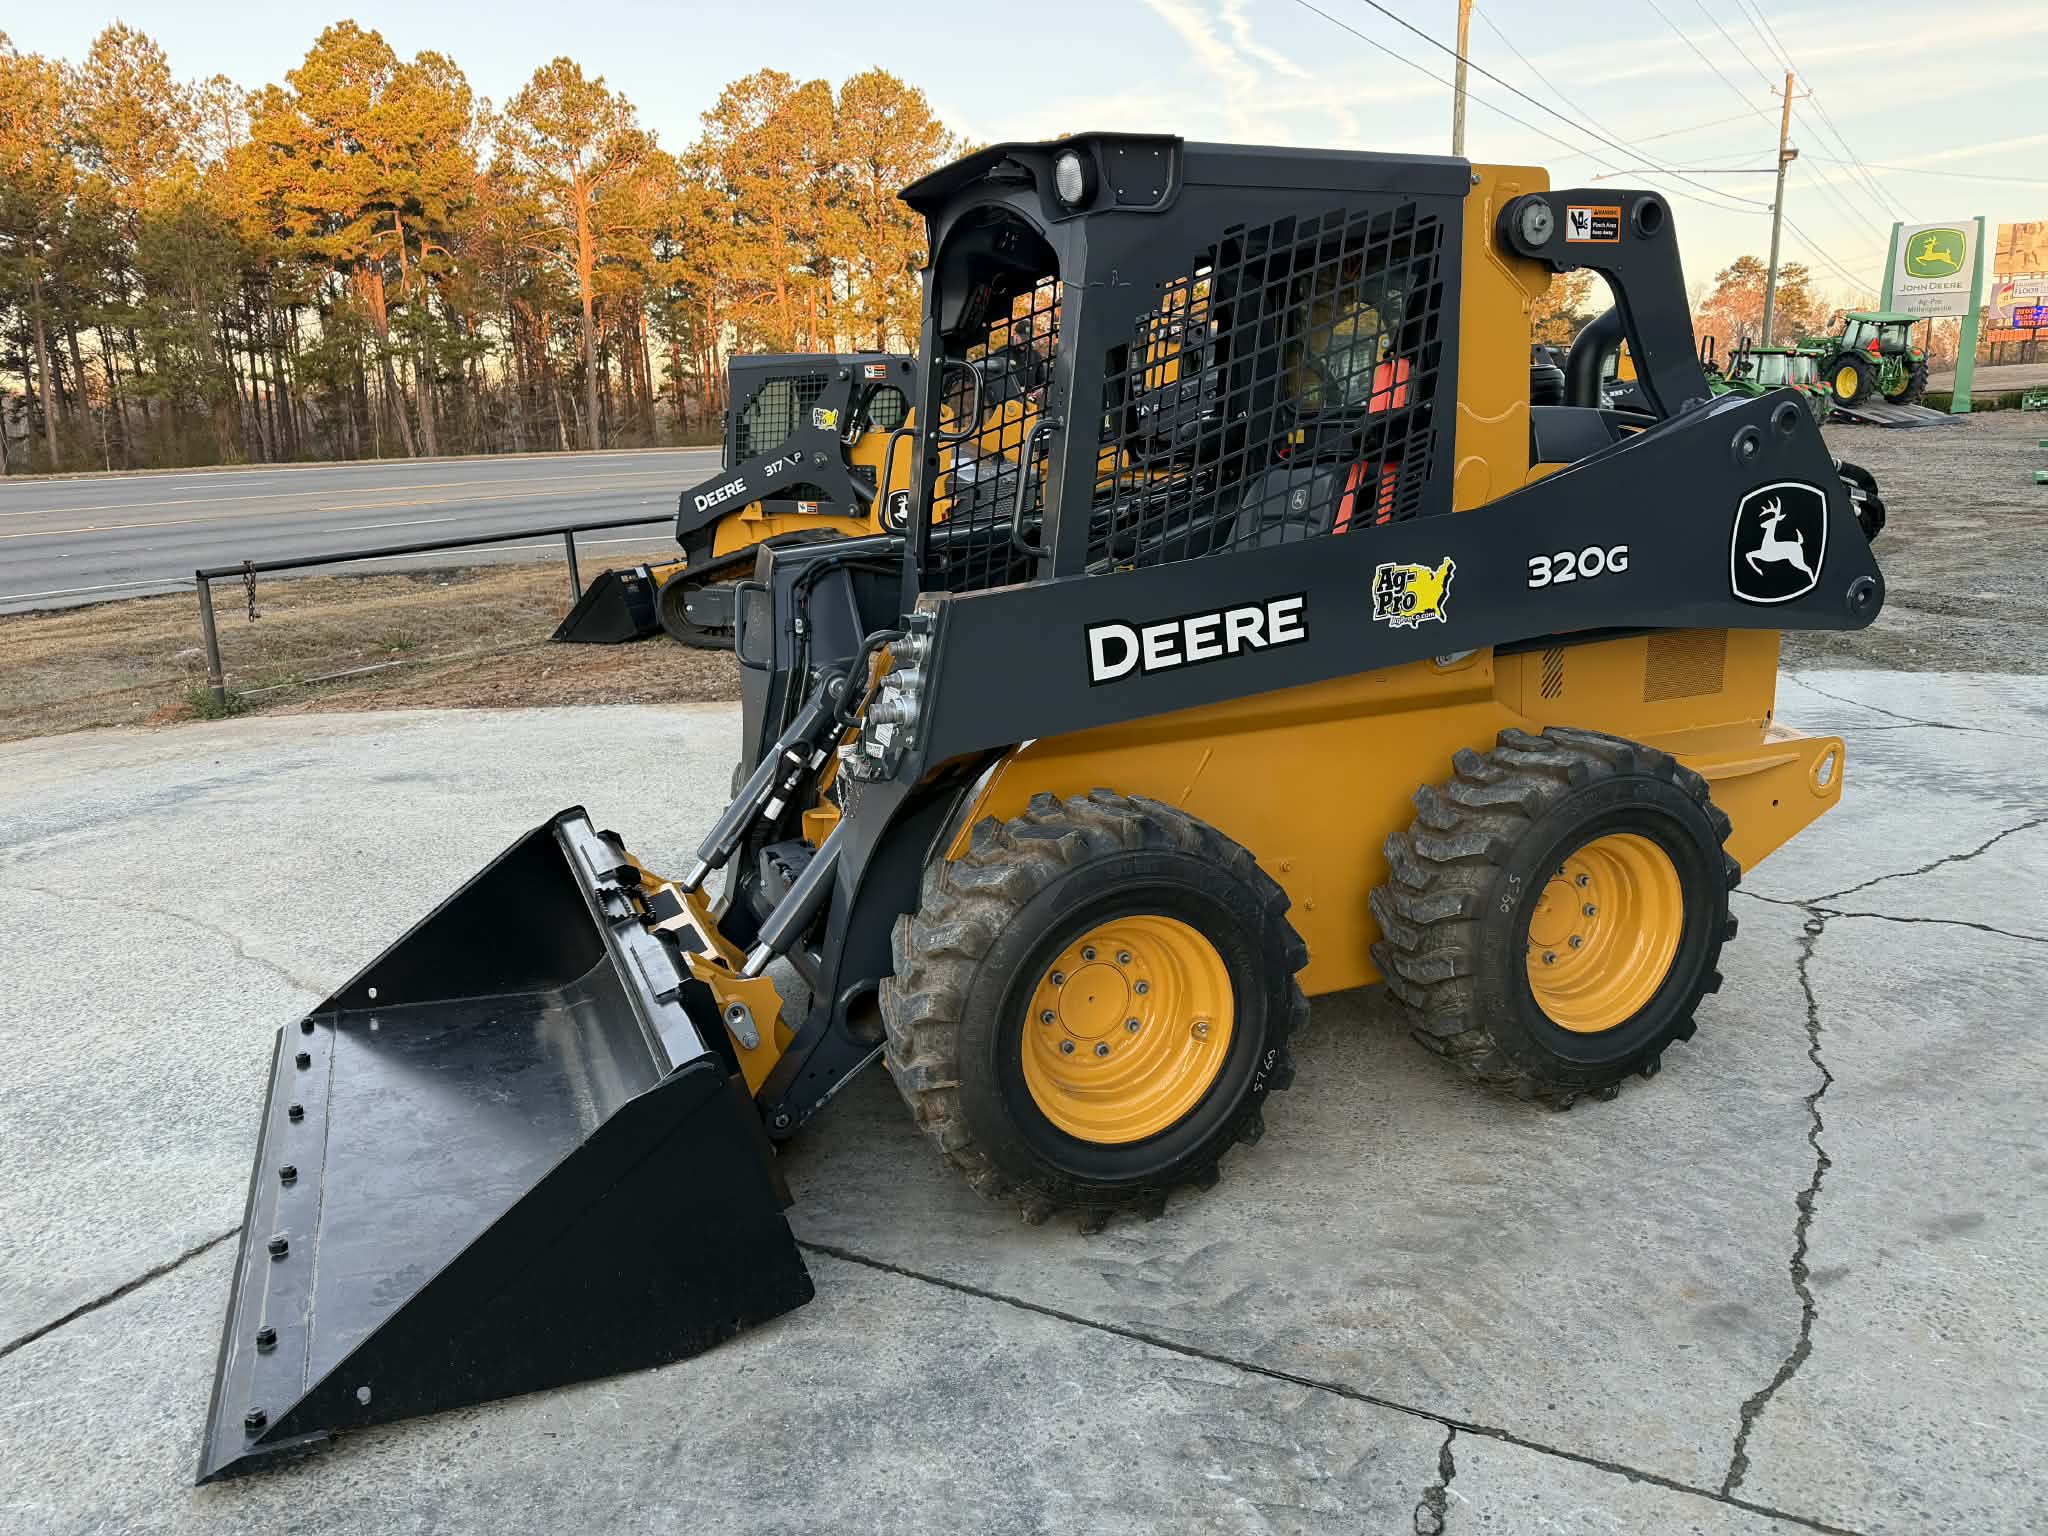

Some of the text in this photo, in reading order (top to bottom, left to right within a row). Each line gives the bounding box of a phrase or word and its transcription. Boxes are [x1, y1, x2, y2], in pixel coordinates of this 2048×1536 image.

[1899, 281, 1963, 292] JOHN DEERE
[694, 477, 747, 513] DEERE
[1528, 545, 1629, 588] 320G
[1376, 591, 1417, 617] Pro
[1089, 597, 1305, 682] DEERE
